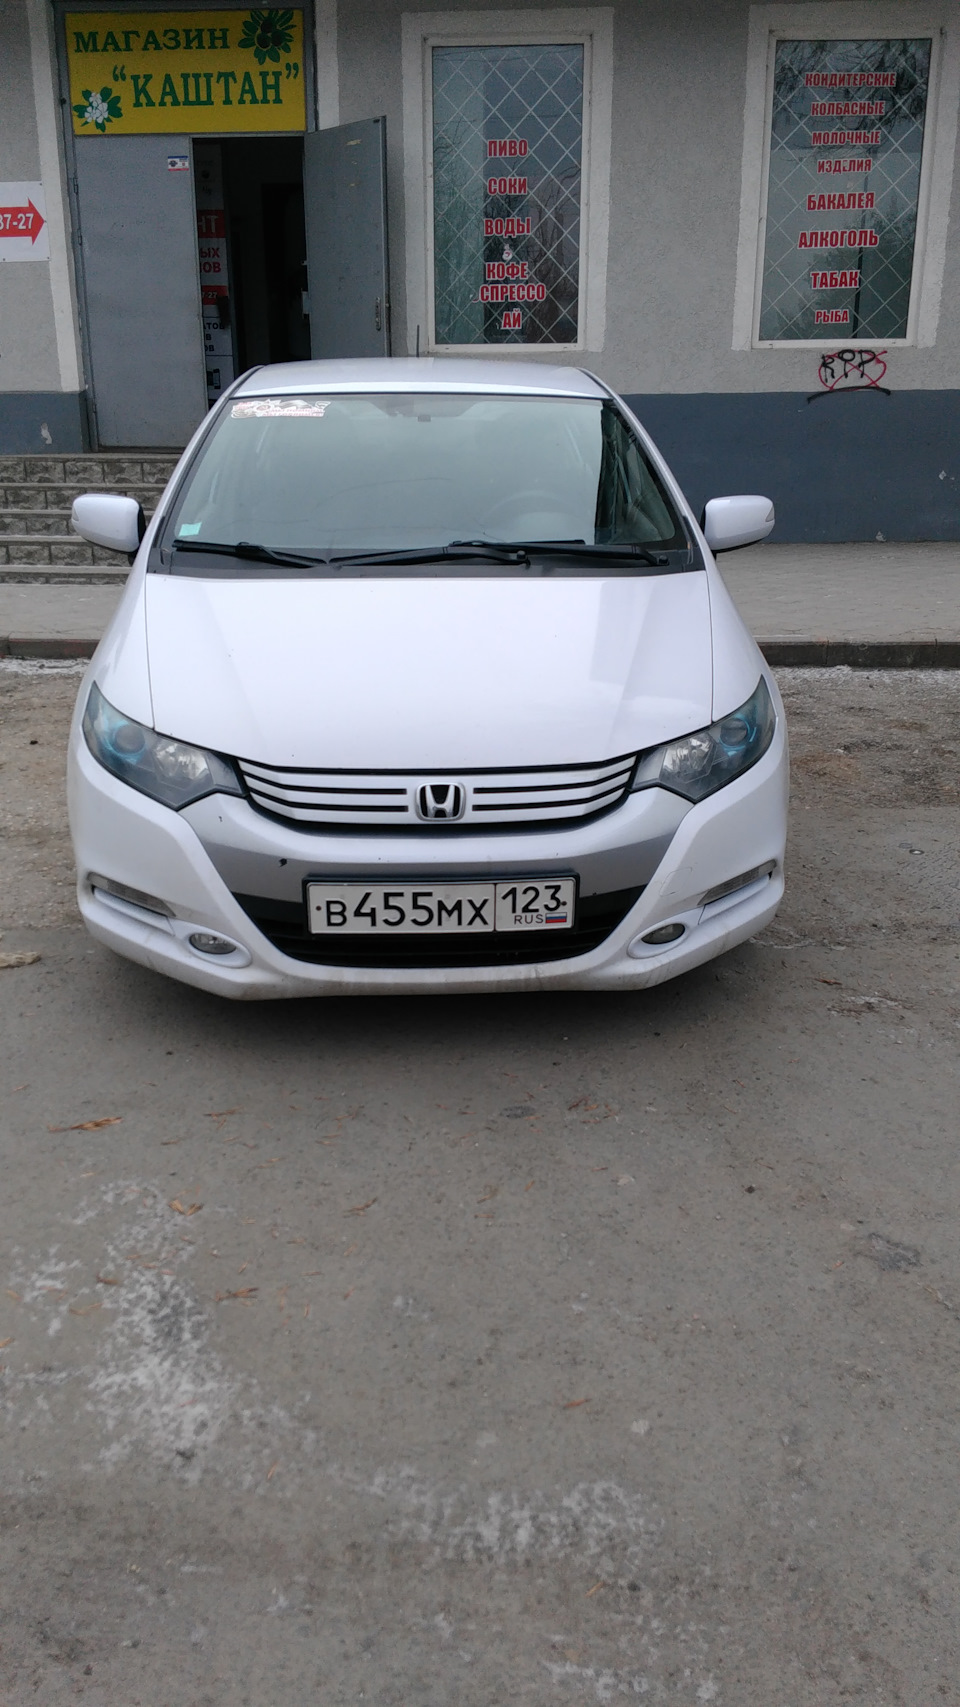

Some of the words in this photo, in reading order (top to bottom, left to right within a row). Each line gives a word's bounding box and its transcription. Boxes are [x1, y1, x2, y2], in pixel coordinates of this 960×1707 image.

[73, 28, 230, 53] МАГАЗИН
[805, 72, 896, 88] КОНДИТЕРСКИЕ
[811, 101, 885, 116] КОЛБАСНЫЕ
[812, 130, 881, 146] МОЛОЧНЫЕ
[488, 139, 528, 157] ПИВО
[817, 158, 872, 174] ИЗДЕЛИЯ
[488, 177, 527, 195] СОКИ
[807, 193, 875, 211] БАКАЛЕЯ
[484, 217, 531, 238] ВОДЫ
[799, 230, 878, 248] АЛКОГОЛЬ
[486, 262, 528, 279] КОФЕ
[811, 270, 860, 288] ТАБАК
[815, 310, 849, 324] РЫБА
[501, 885, 562, 914] 123
[514, 914, 544, 925] RUS
